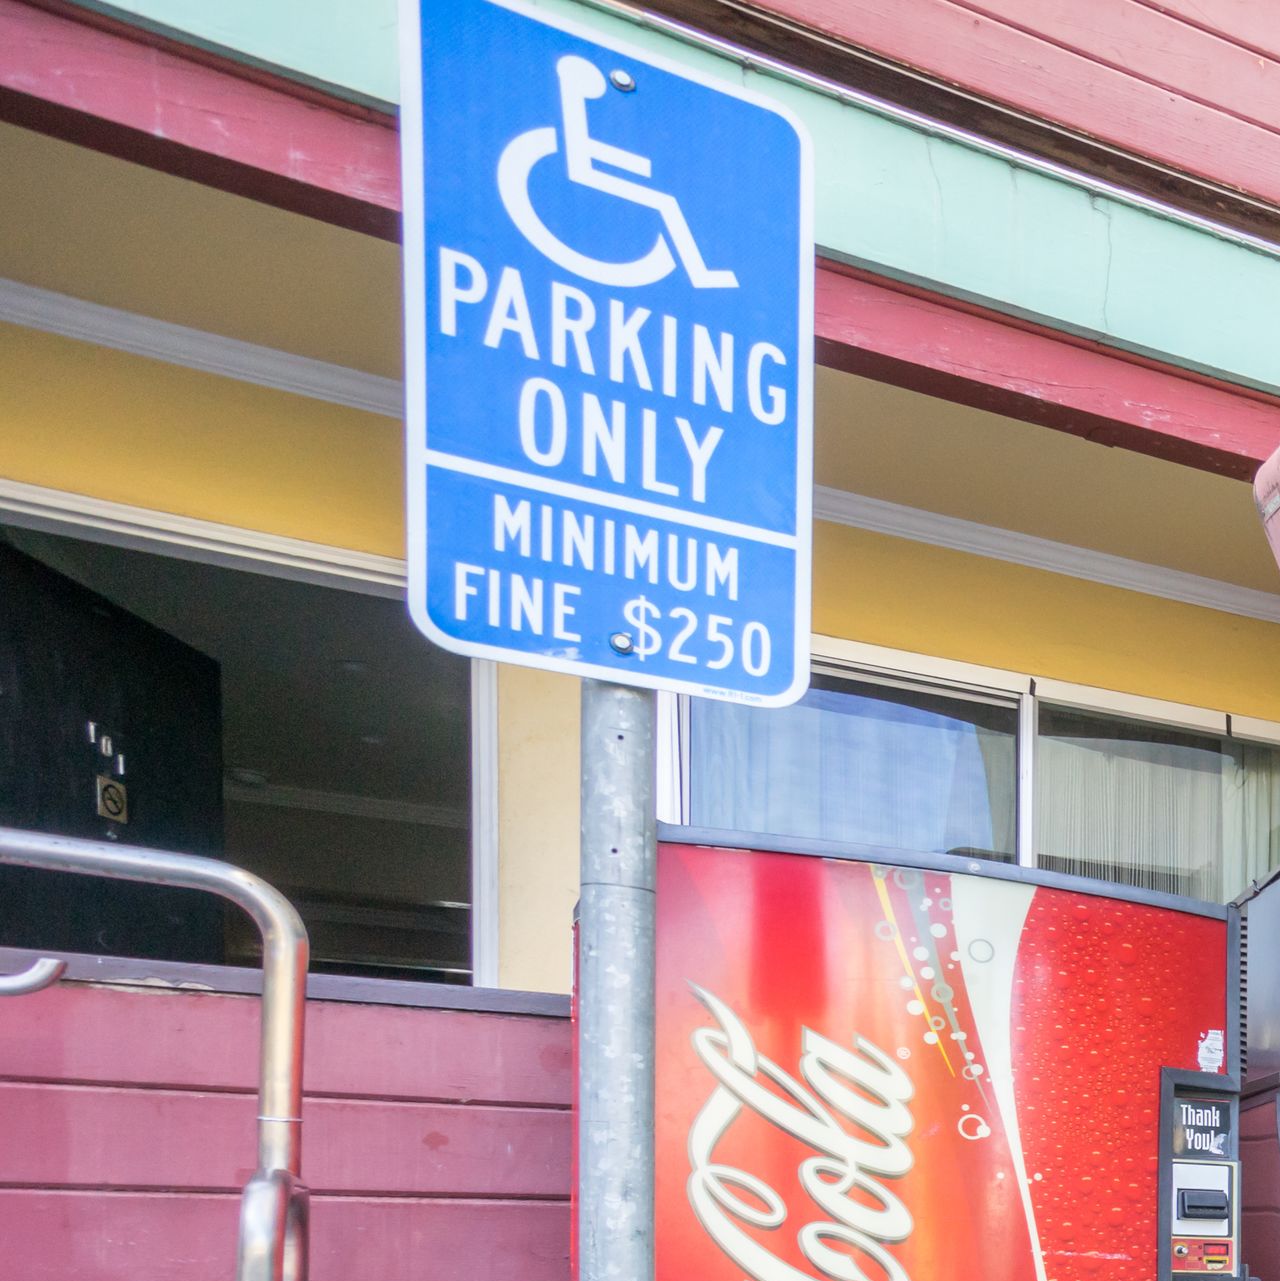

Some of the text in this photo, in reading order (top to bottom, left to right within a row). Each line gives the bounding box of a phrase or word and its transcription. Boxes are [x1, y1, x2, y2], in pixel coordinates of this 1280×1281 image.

[440, 247, 787, 426] PARKING
[519, 377, 723, 502] ONLY
[493, 494, 739, 601] MINIMUM
[454, 562, 772, 677] FINE $250
[1180, 1104, 1220, 1127] Thank
